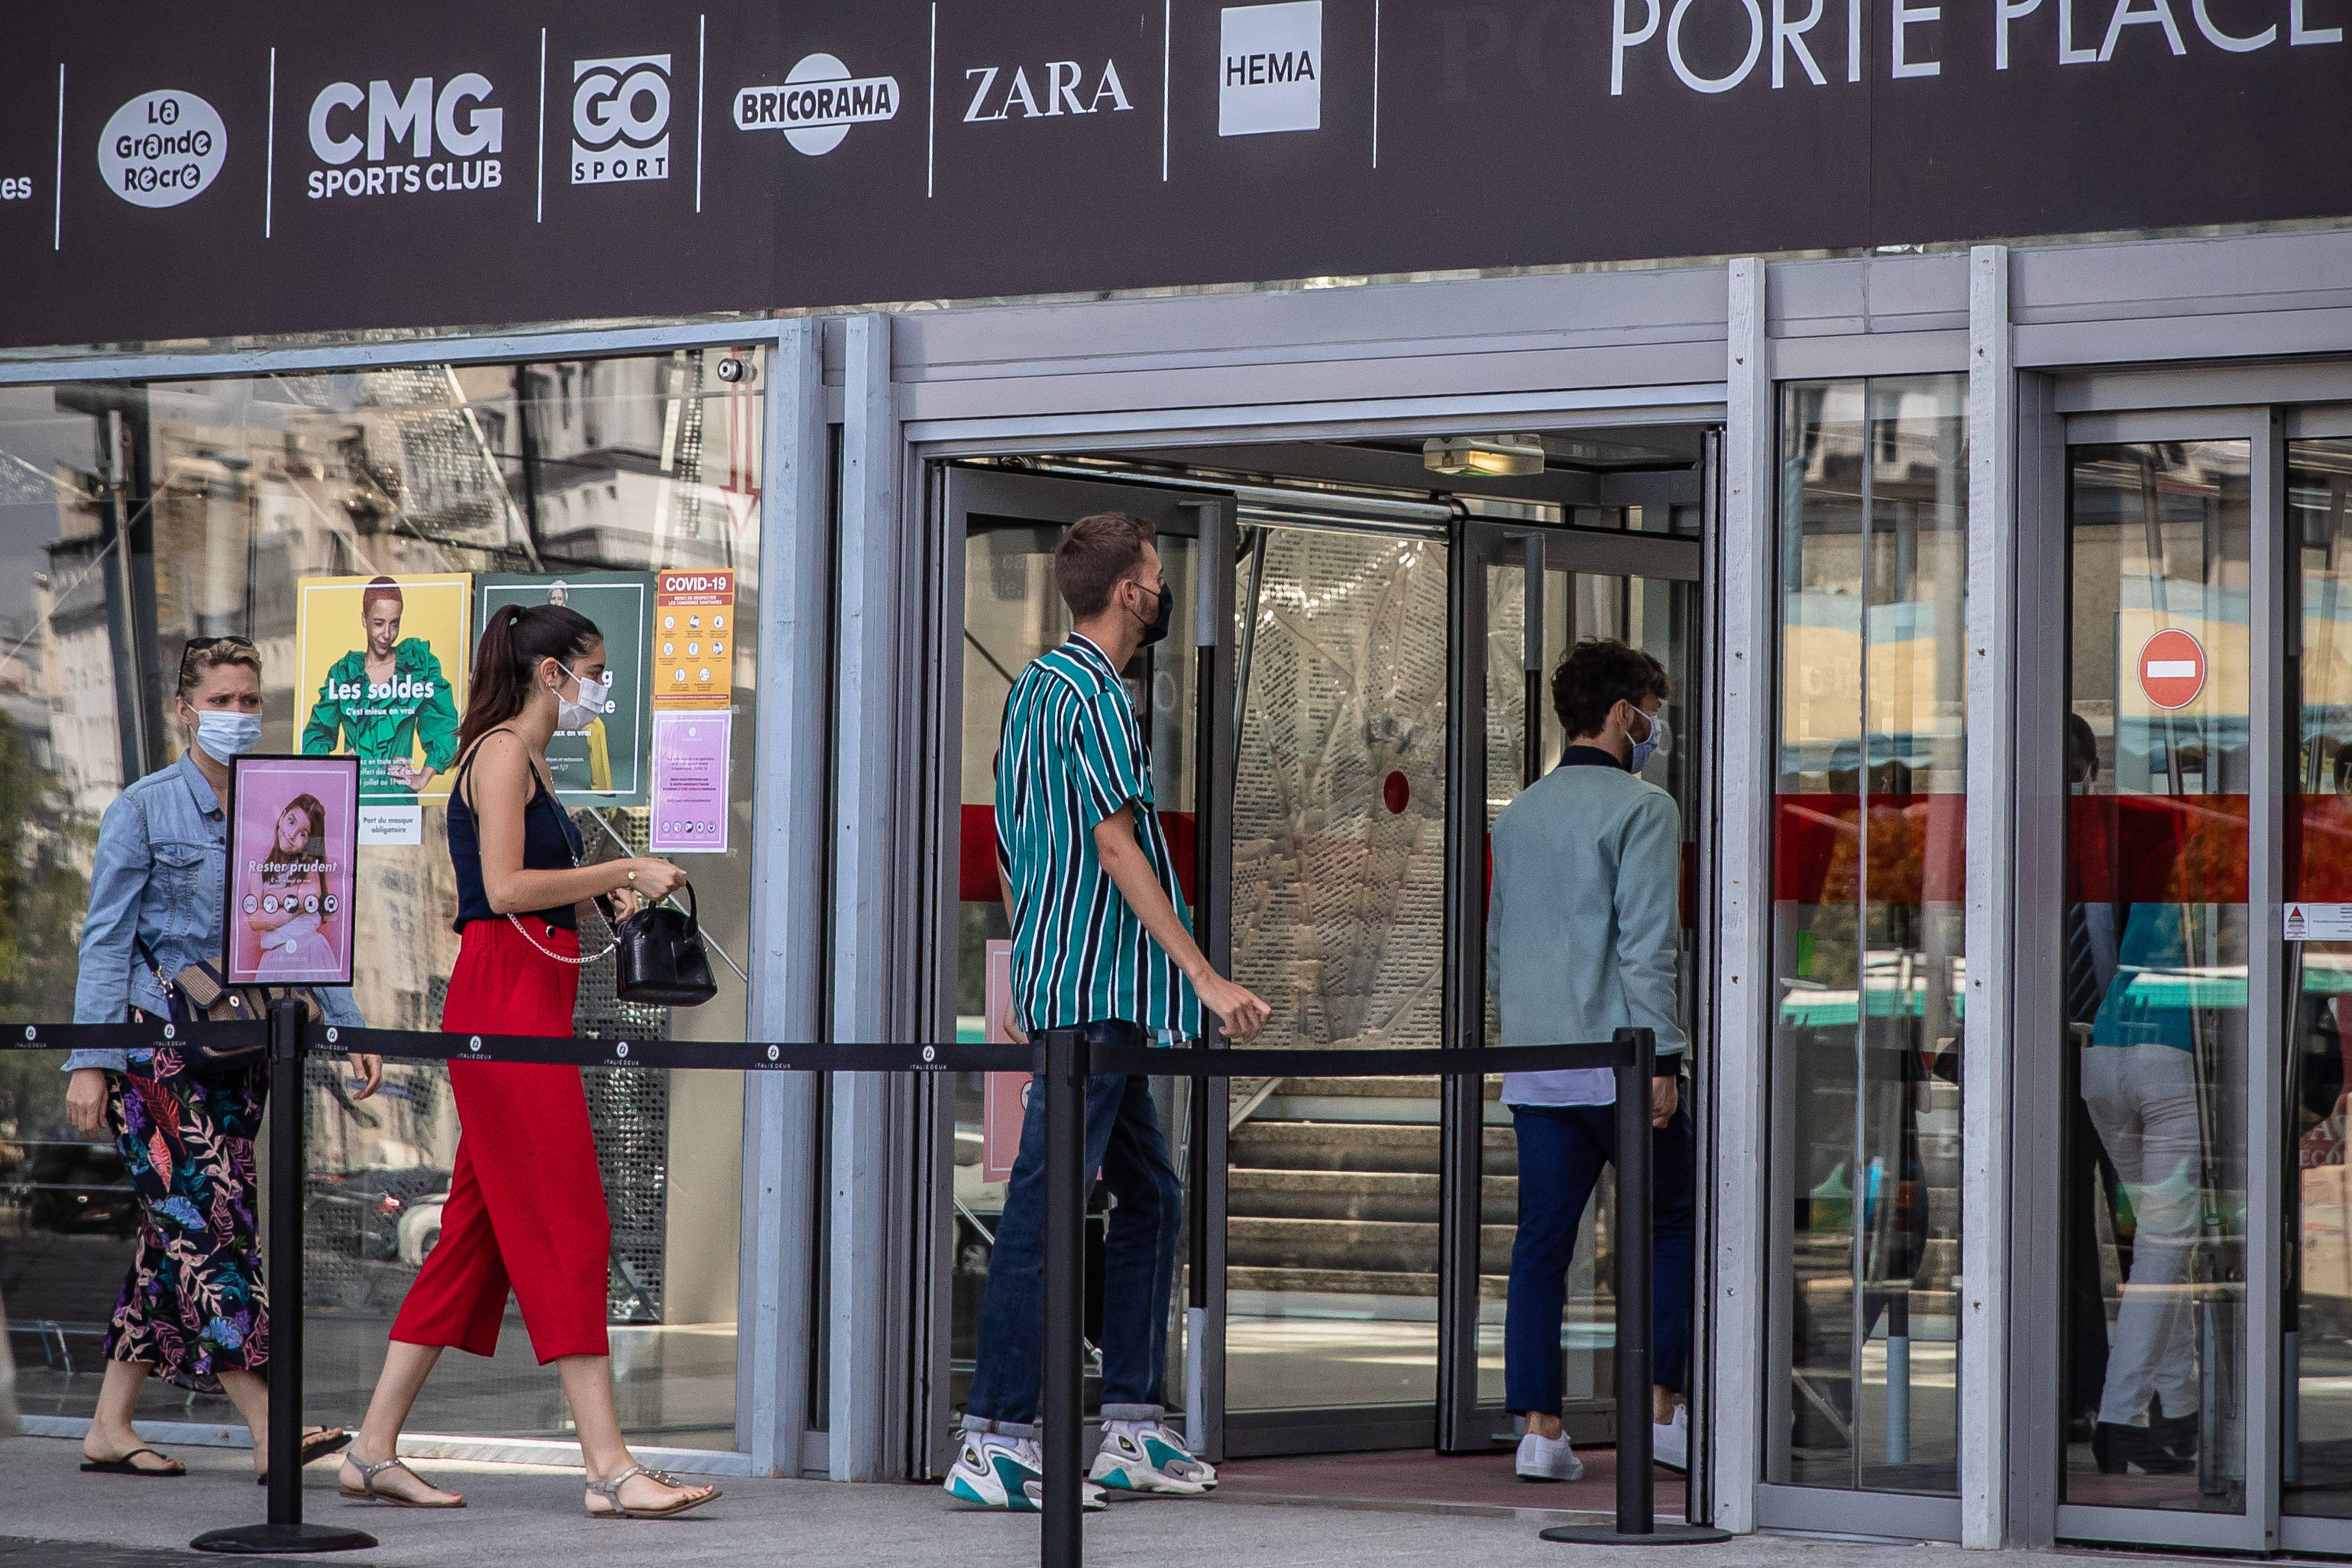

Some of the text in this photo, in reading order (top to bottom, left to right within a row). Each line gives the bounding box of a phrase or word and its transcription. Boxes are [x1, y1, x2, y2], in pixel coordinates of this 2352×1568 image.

[1611, 0, 1941, 95] PORTE
[1226, 50, 1315, 87] HEMA
[741, 82, 893, 124] BRICORAMA
[962, 58, 1134, 123] ZARA
[309, 73, 503, 165] CMG
[572, 70, 671, 144] GO
[116, 129, 212, 160] Grande
[307, 159, 502, 199] SPORTS CLUB
[574, 157, 665, 182] SPORT
[0, 176, 32, 200] es
[665, 576, 726, 592] COVID-19
[328, 674, 435, 700] Les soldes
[345, 707, 363, 716] C'est
[364, 707, 387, 716] mieux
[400, 706, 416, 715] vrai
[371, 826, 406, 835] obligatoire
[248, 858, 338, 875] Rester prudent
